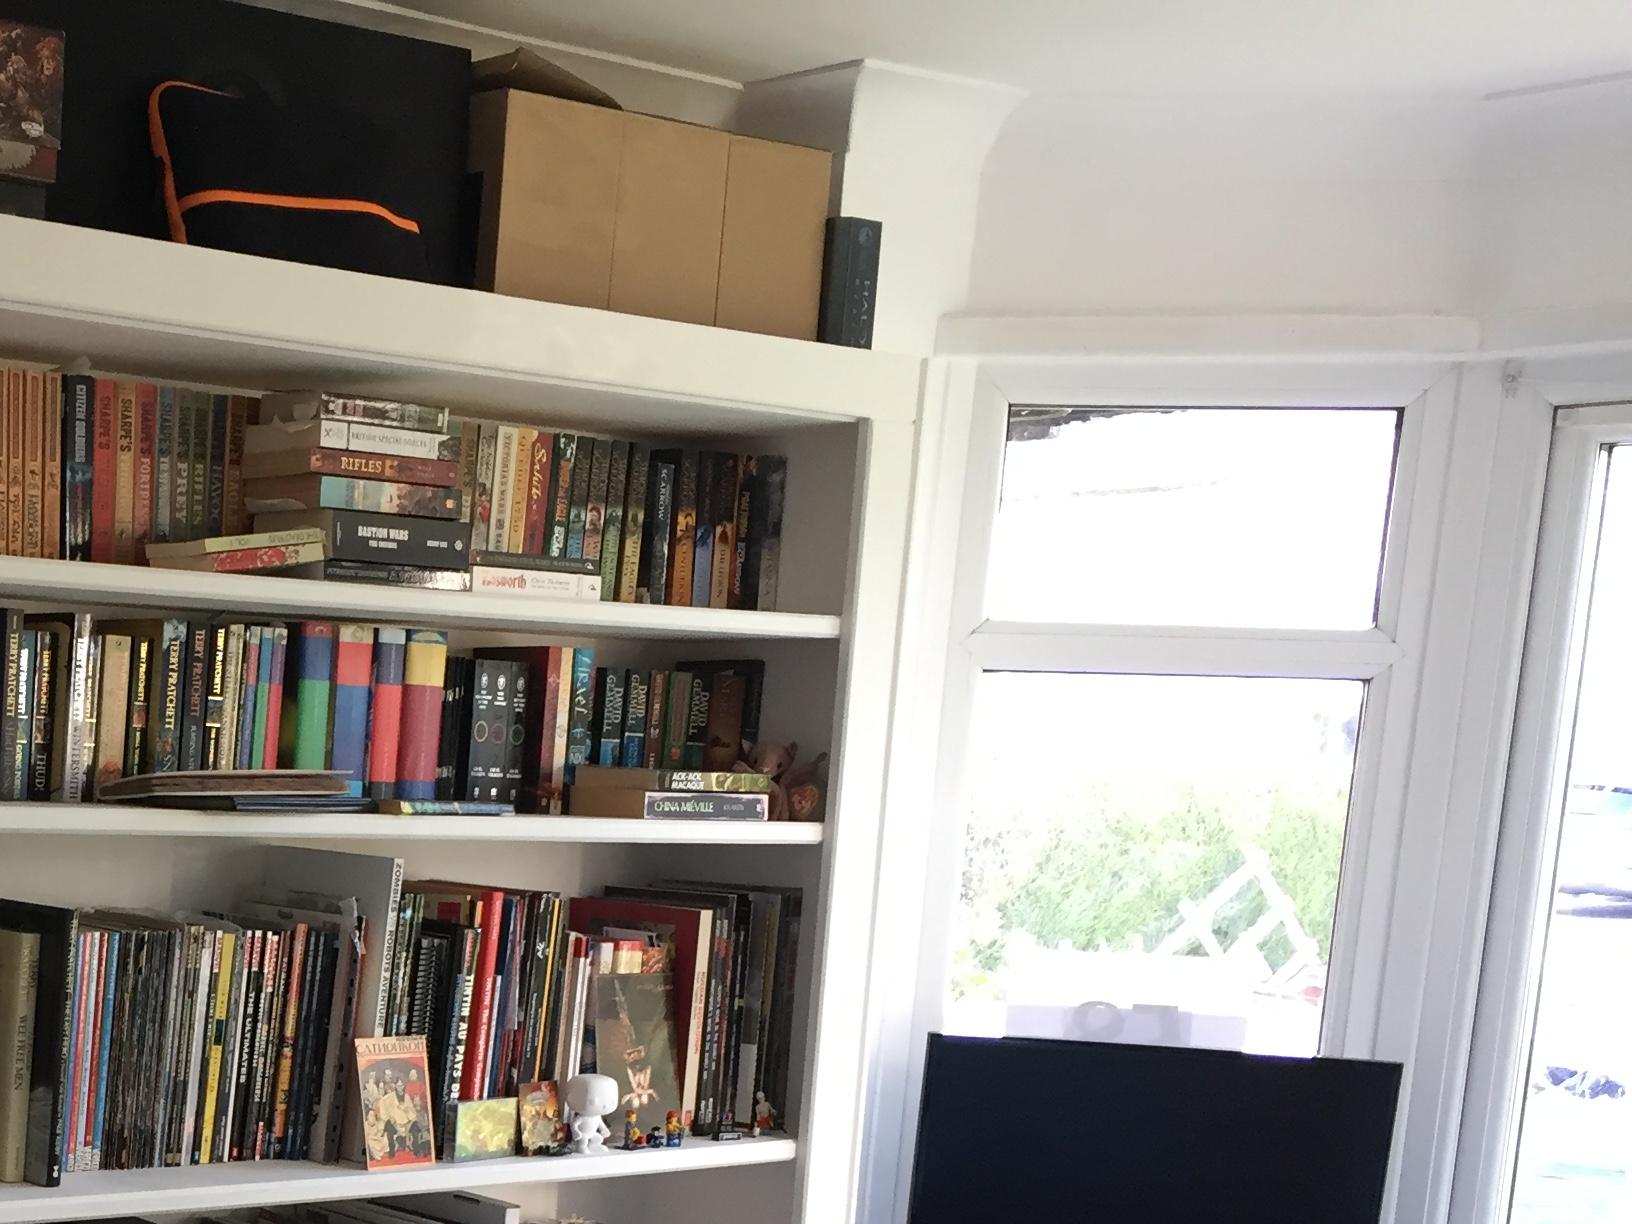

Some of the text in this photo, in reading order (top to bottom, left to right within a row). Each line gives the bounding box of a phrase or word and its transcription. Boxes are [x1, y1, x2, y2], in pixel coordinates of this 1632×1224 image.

[75, 384, 87, 419] CITIZEN
[119, 398, 133, 452] SHARPE'S
[339, 456, 382, 473] RIFLES
[175, 461, 189, 524] PREY
[356, 525, 387, 539] BASTION
[6, 632, 20, 718] TERRY PRATCHETT
[164, 639, 181, 730] TERRY PRATCHETT
[190, 629, 206, 717] TERRY PRATCHETT
[213, 628, 226, 695] TERRY PRATCHETT
[602, 674, 617, 733] GEMMELL
[611, 687, 624, 724] DAVID
[626, 673, 640, 726] GEMMELL
[636, 684, 648, 719] DAVID
[688, 679, 703, 736] GEMMELL
[697, 692, 710, 727] DAVID
[35, 752, 47, 792] THUD!
[69, 725, 82, 800] WINTERSMITH
[377, 862, 401, 1029] ZOMBIES ROBOTS AVENTURE
[459, 973, 475, 1017] TINTIN
[13, 1015, 28, 1091] WEE FREE MEN
[239, 991, 255, 1084] THE ULTIMATES
[458, 1021, 470, 1040] AU
[451, 1044, 466, 1078] PAYS
